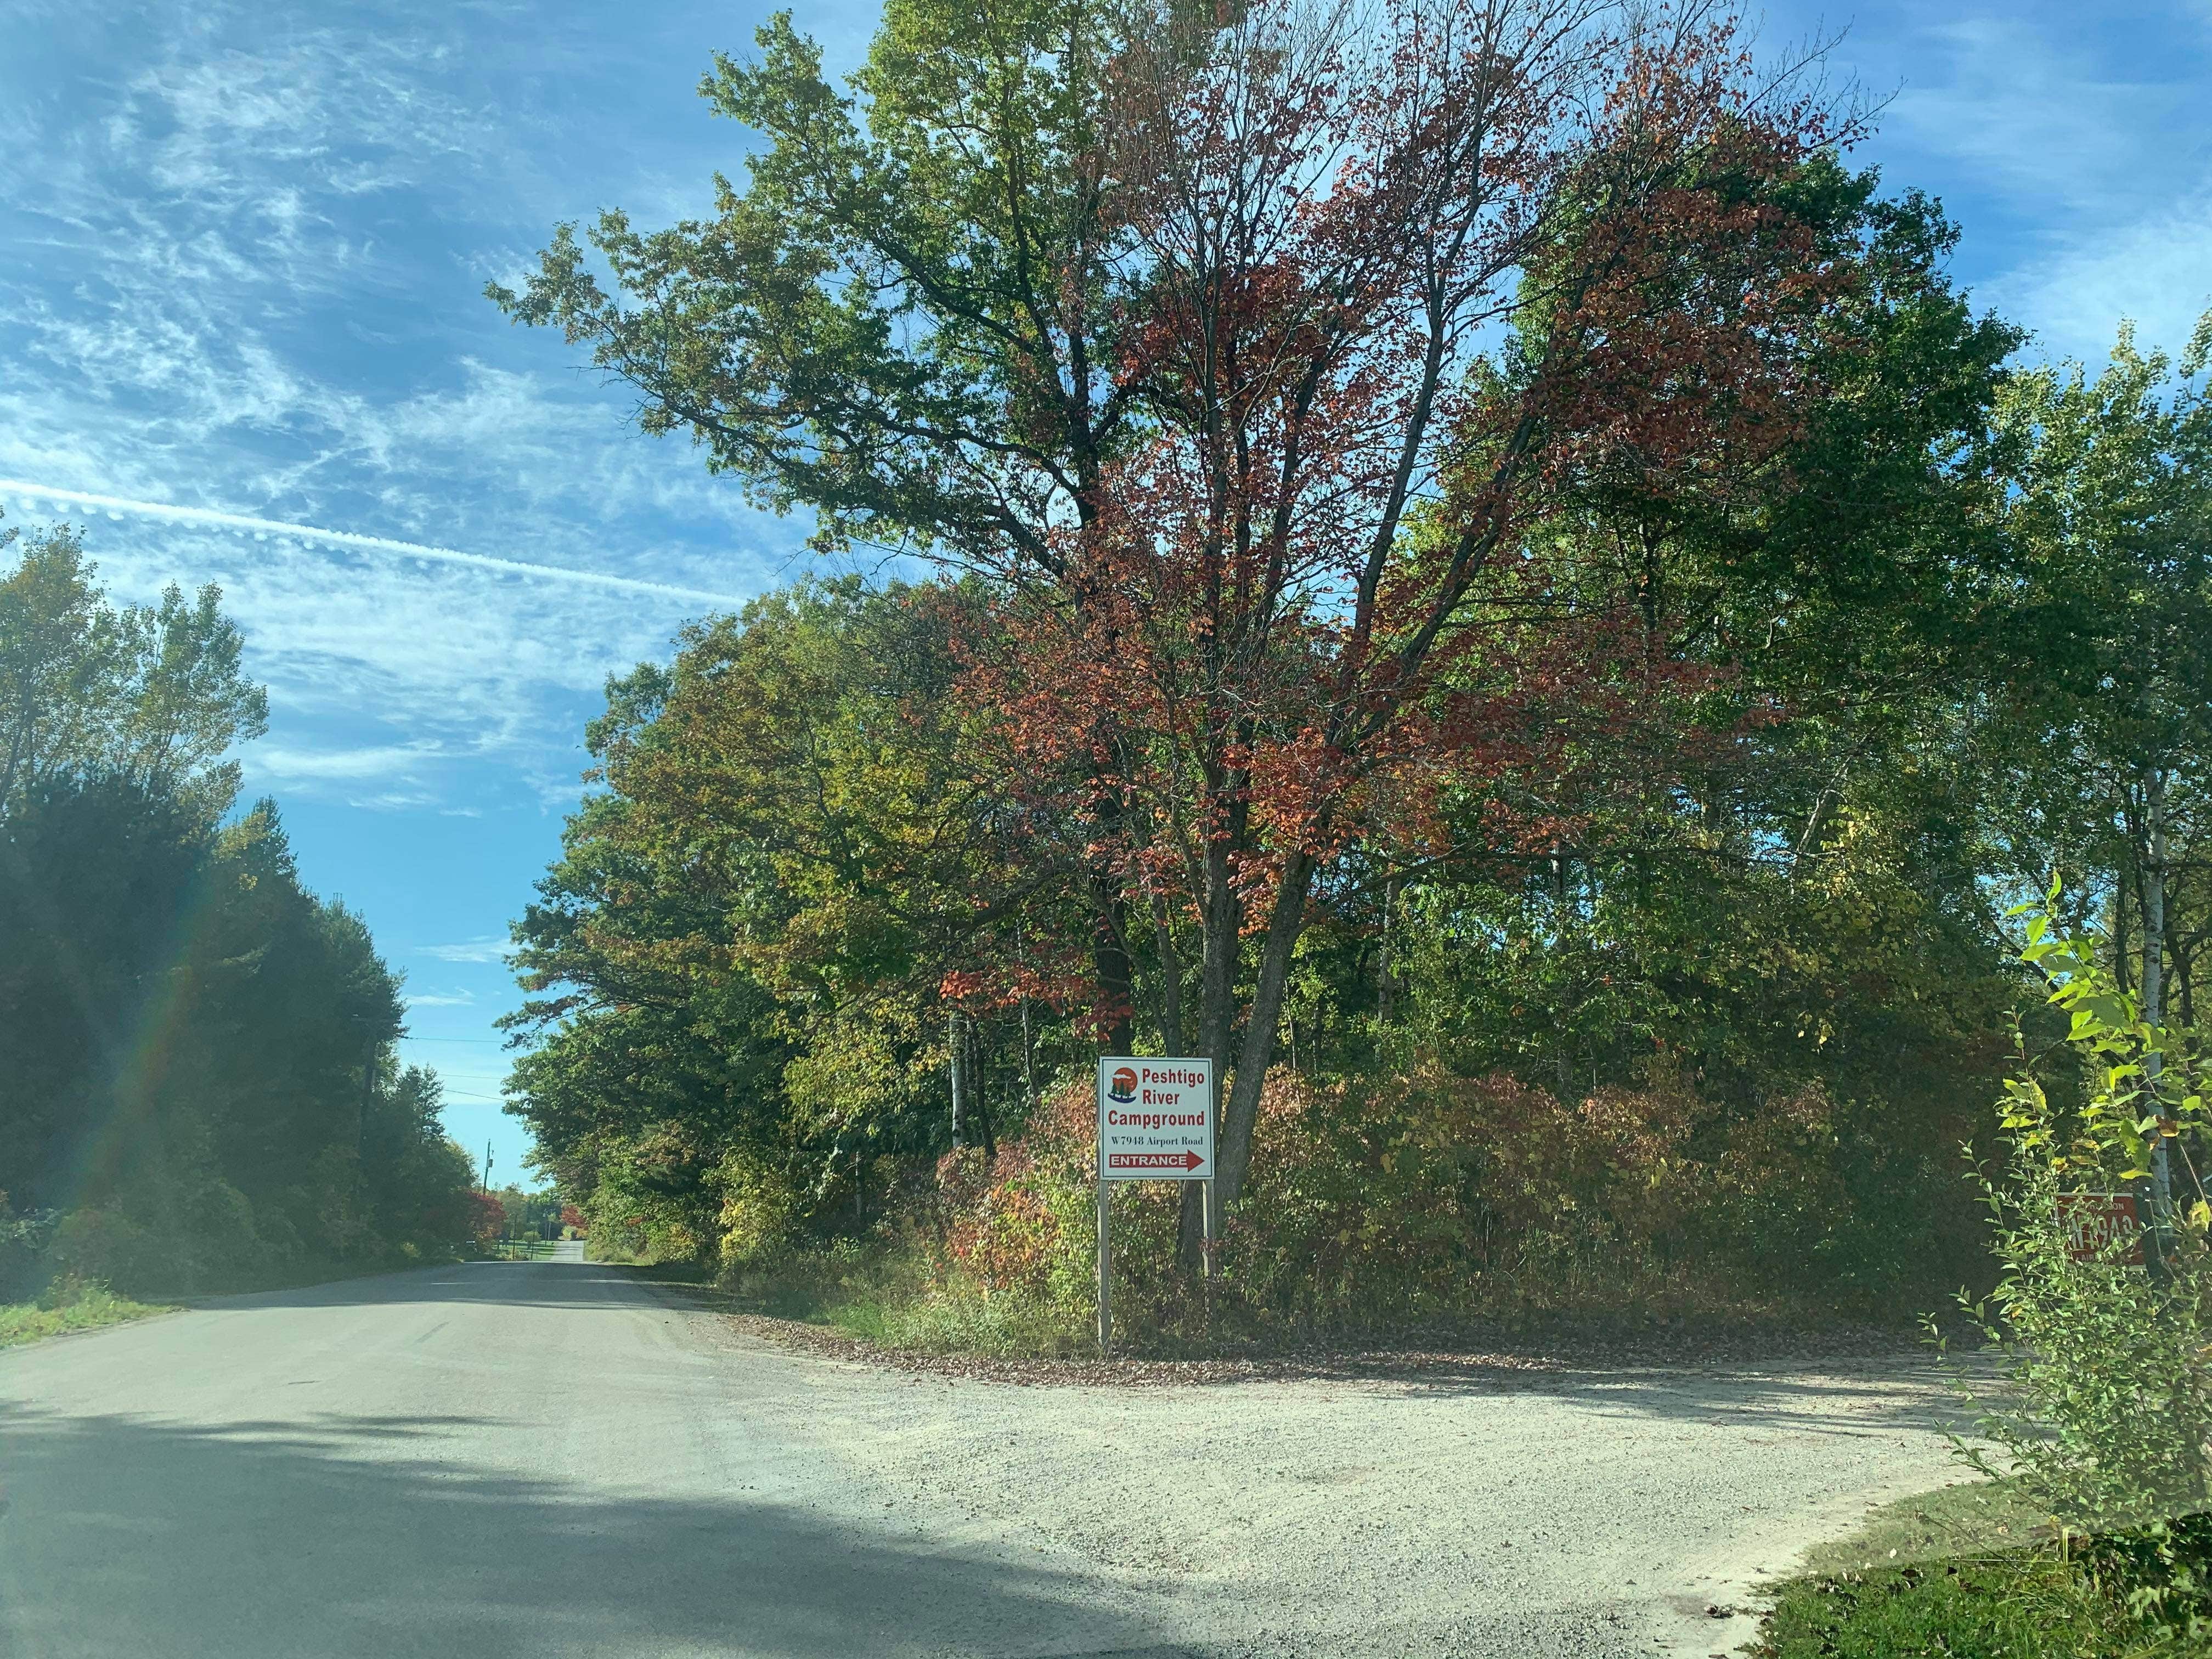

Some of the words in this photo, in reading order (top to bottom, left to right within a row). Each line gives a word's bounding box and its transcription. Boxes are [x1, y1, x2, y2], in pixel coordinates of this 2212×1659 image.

[1142, 1068, 1205, 1087] Peshtigo
[1143, 1090, 1180, 1104] River
[1108, 1110, 1205, 1130] Campground
[1111, 1136, 1144, 1146] W7948
[1147, 1137, 1178, 1147] Airport
[1182, 1137, 1203, 1146] Road
[1111, 1155, 1187, 1166] ENTRANCE
